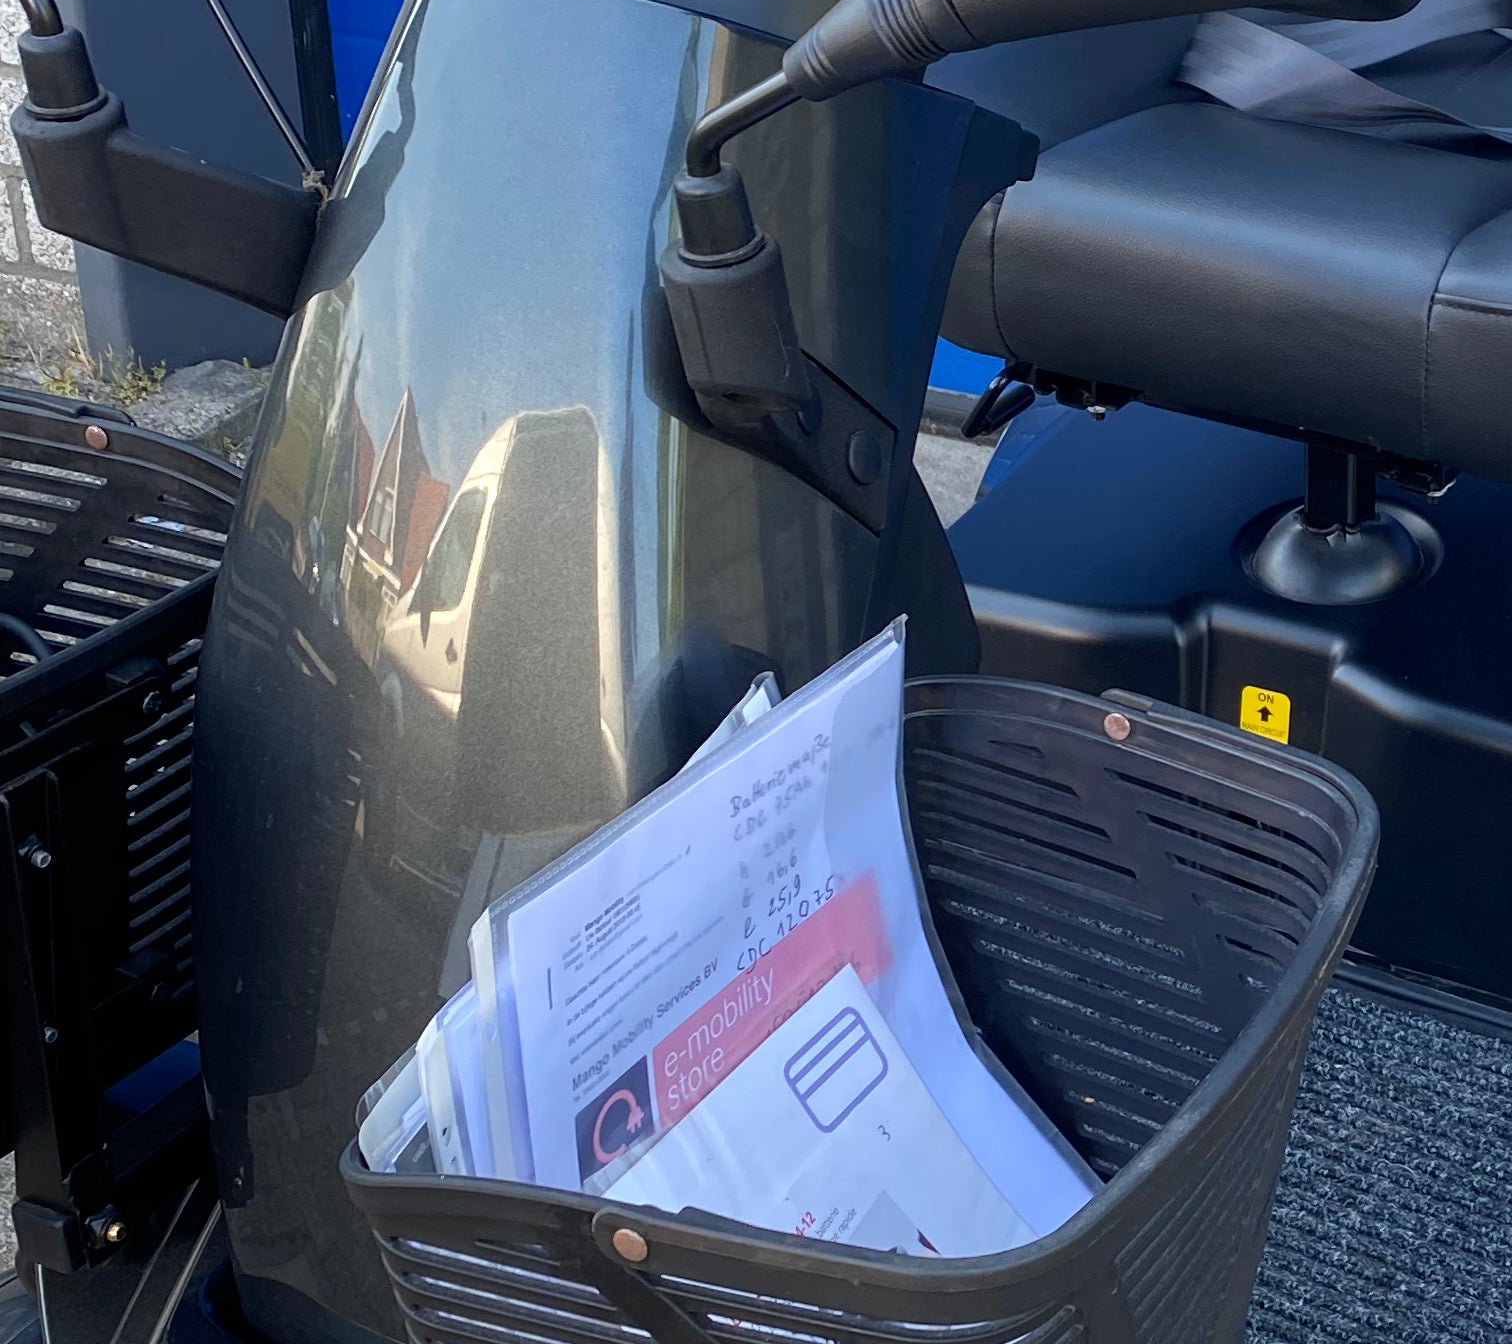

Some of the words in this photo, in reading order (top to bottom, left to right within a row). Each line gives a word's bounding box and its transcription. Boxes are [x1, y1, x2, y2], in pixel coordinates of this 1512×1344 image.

[1258, 693, 1274, 703] ON
[1241, 721, 1259, 733] MAIN
[736, 937, 773, 974] CDC
[571, 1053, 611, 1091] Mango
[611, 1014, 654, 1057] Mobility
[656, 975, 702, 1018] Services
[703, 957, 718, 980] BV
[664, 967, 774, 1078] e-mobility
[667, 1047, 724, 1111] store
